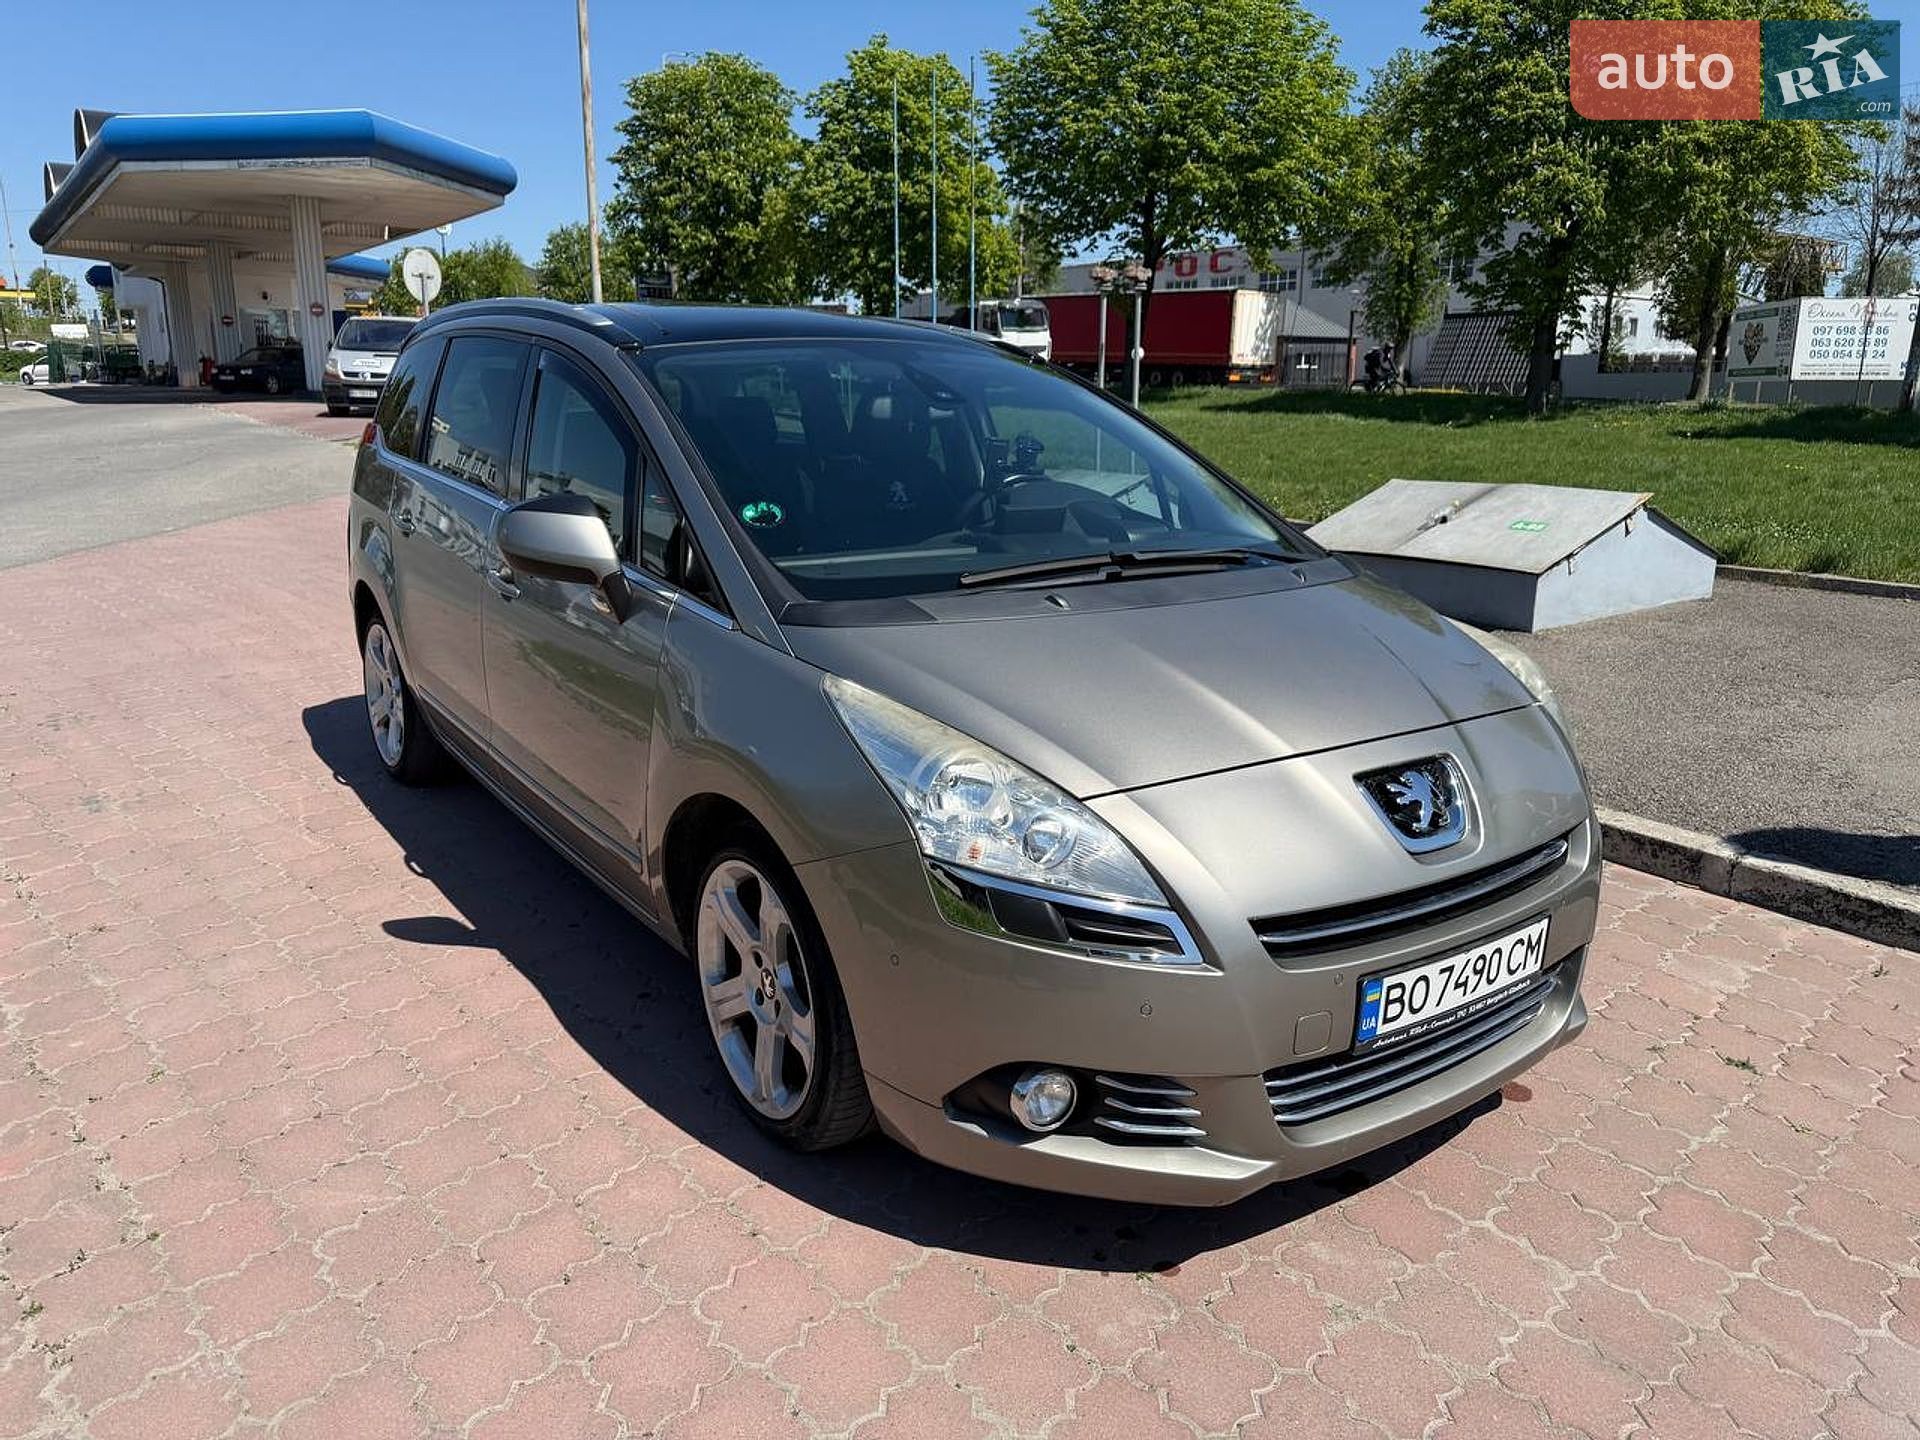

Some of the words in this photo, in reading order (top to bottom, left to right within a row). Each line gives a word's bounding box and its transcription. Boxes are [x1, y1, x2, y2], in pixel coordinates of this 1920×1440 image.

[1812, 325, 1833, 336] 097
[1835, 325, 1857, 336] 698
[1810, 337, 1831, 348] 063
[1834, 337, 1855, 348] 620
[1808, 349, 1830, 359] 050
[1831, 349, 1853, 359] 054
[1871, 349, 1886, 359] 24
[1381, 974, 1430, 1025] BO
[1435, 950, 1503, 1008] 7490
[1507, 928, 1544, 975] CM
[1362, 1016, 1377, 1031] UA
